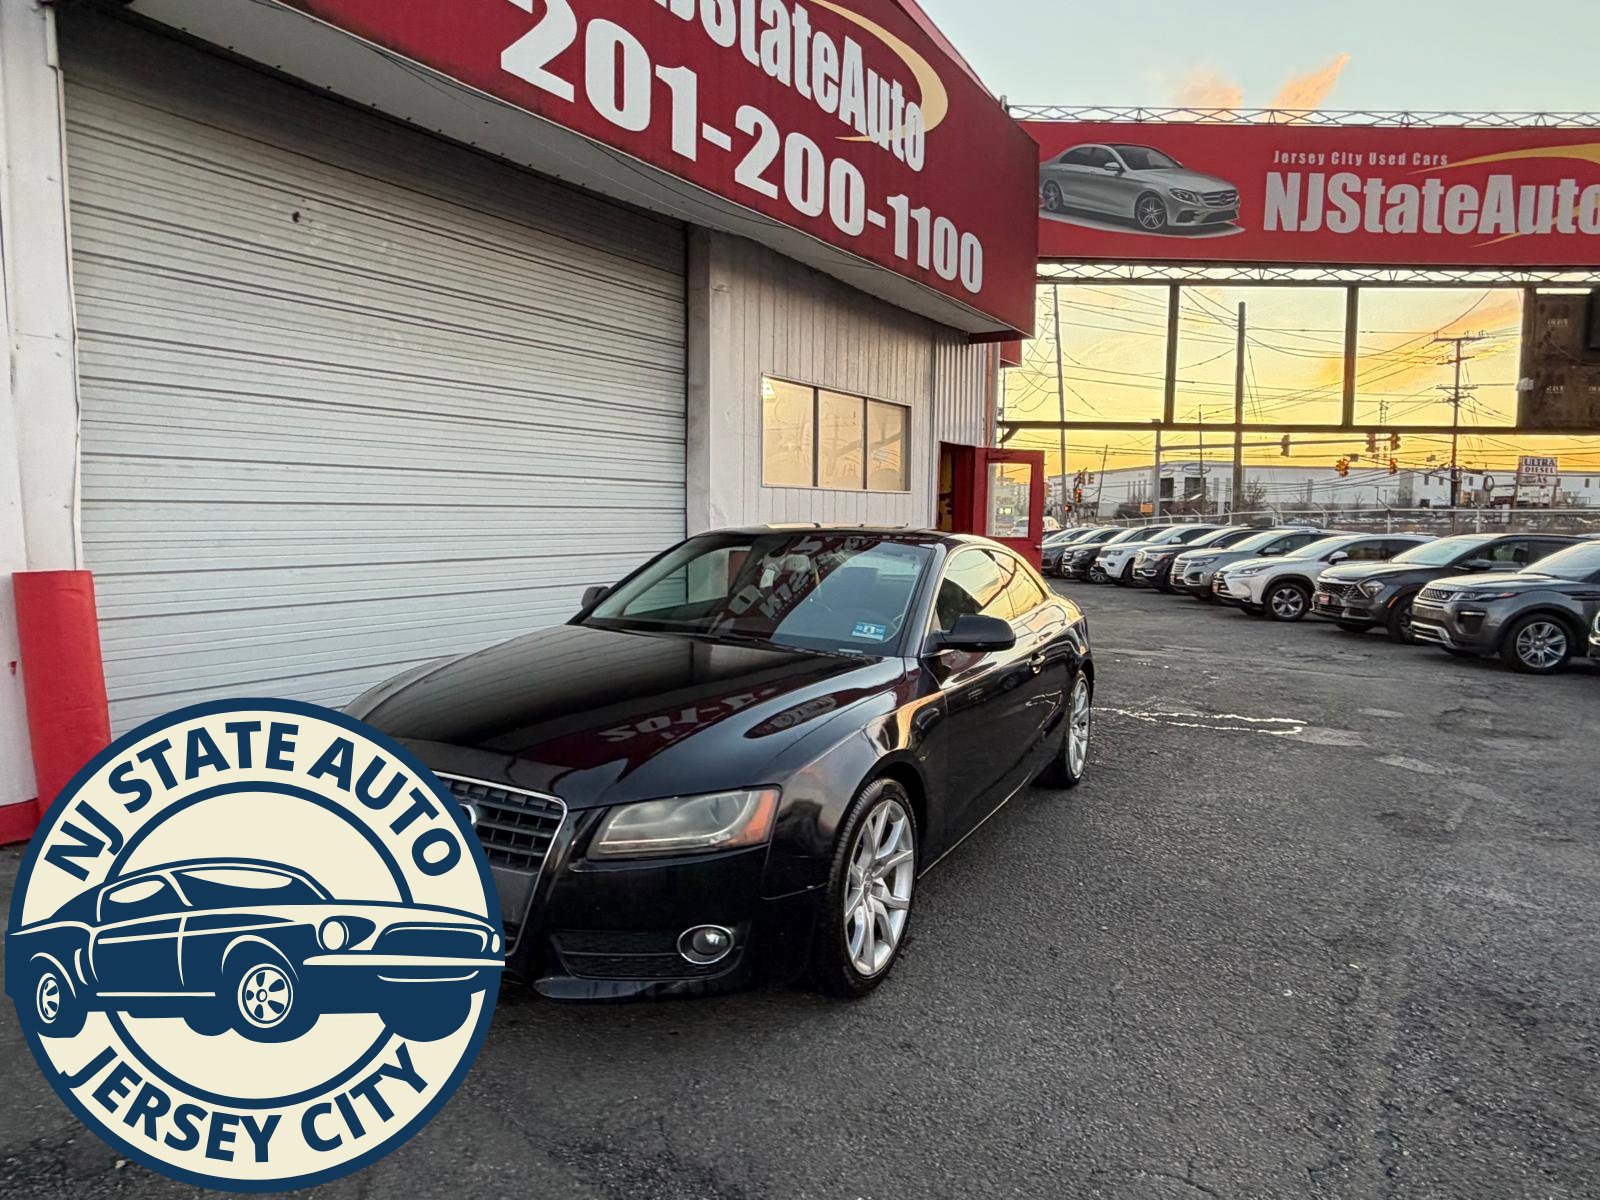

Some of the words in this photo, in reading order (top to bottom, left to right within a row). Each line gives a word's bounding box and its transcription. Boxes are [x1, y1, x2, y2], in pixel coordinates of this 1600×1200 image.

[501, 0, 983, 294] 201-200-1100
[1273, 150, 1325, 167] Jersey
[1331, 151, 1363, 167] City
[1369, 152, 1406, 166] Used
[1412, 152, 1449, 167] Cars
[1263, 171, 1600, 235] NJStateAuto
[1524, 458, 1555, 467] ULTRA
[1525, 466, 1554, 474] DIESEL
